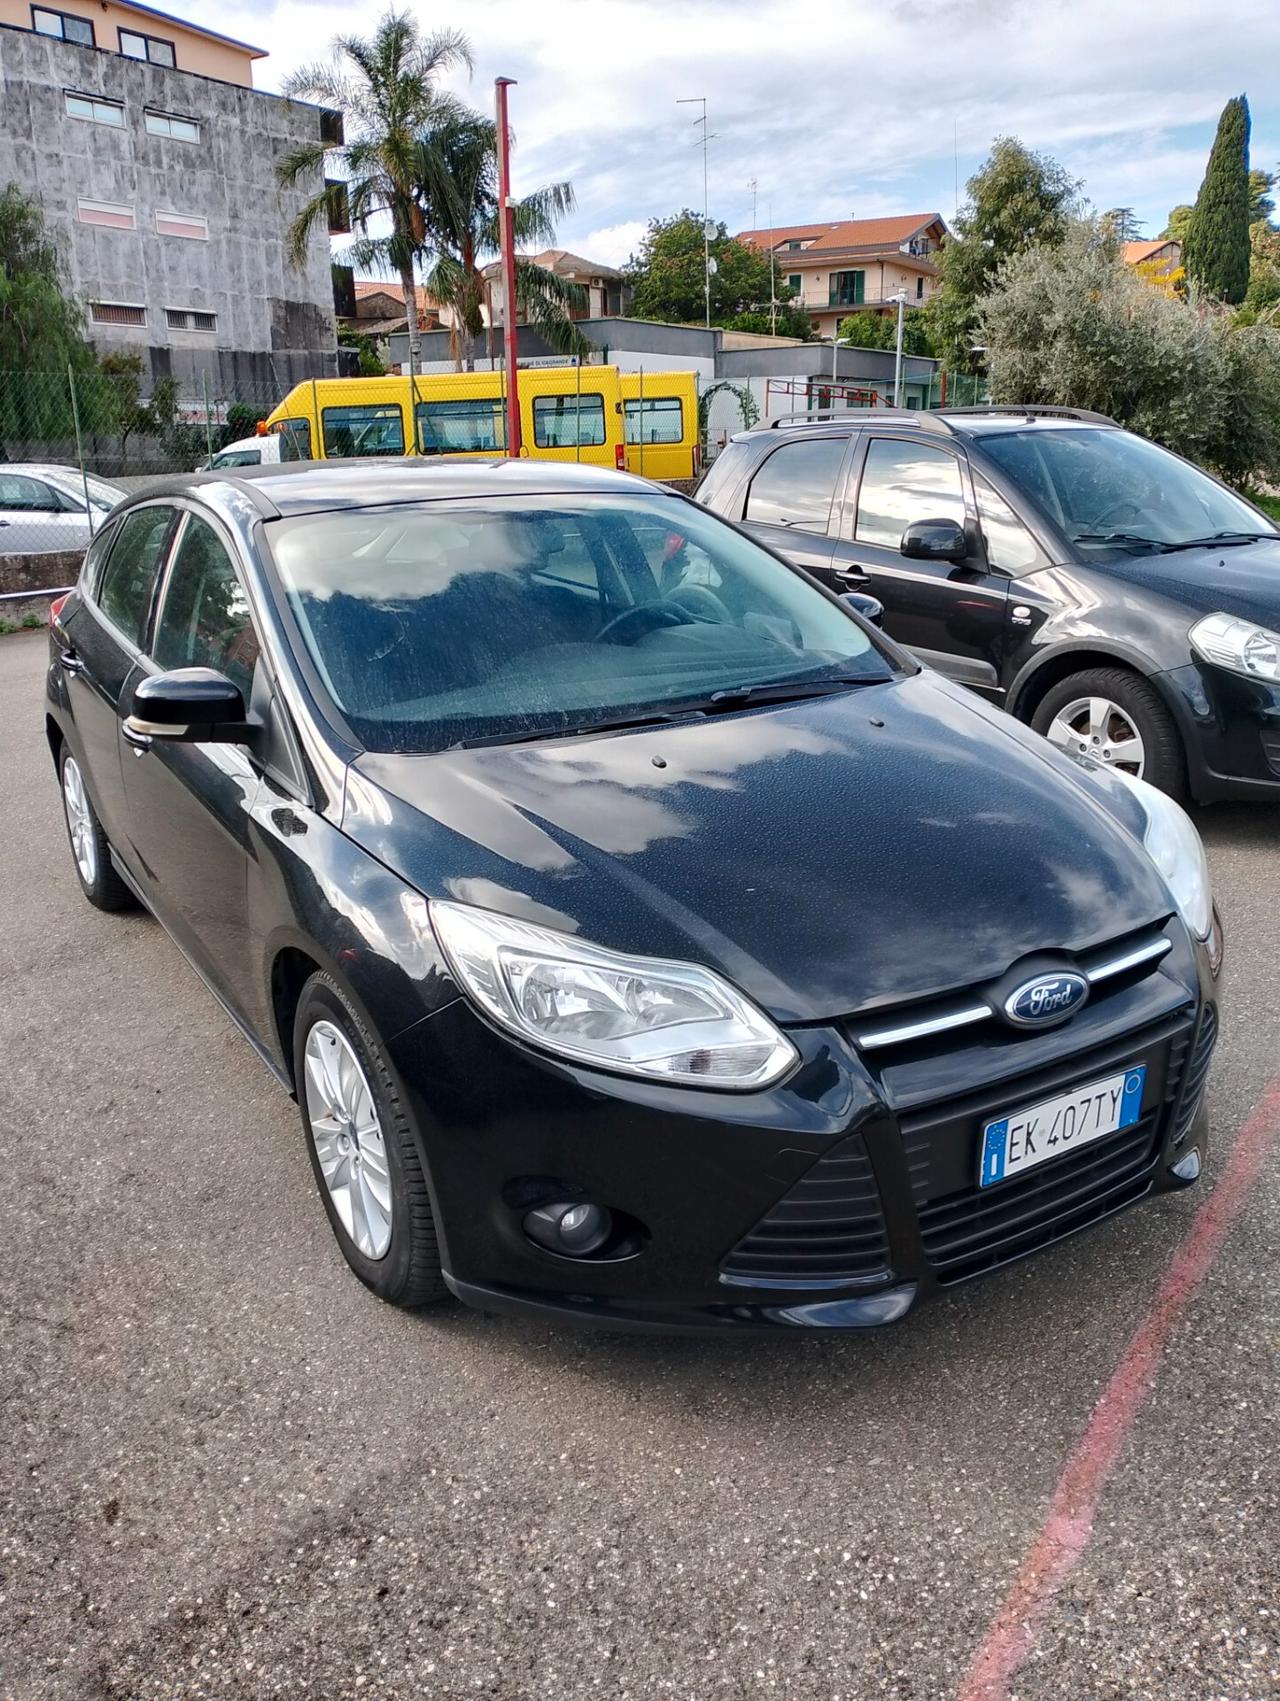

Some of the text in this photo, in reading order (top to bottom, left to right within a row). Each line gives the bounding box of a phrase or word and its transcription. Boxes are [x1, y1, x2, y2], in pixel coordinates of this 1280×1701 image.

[1016, 981, 1073, 1016] Ford
[1008, 1085, 1122, 1164] EK 407TY
